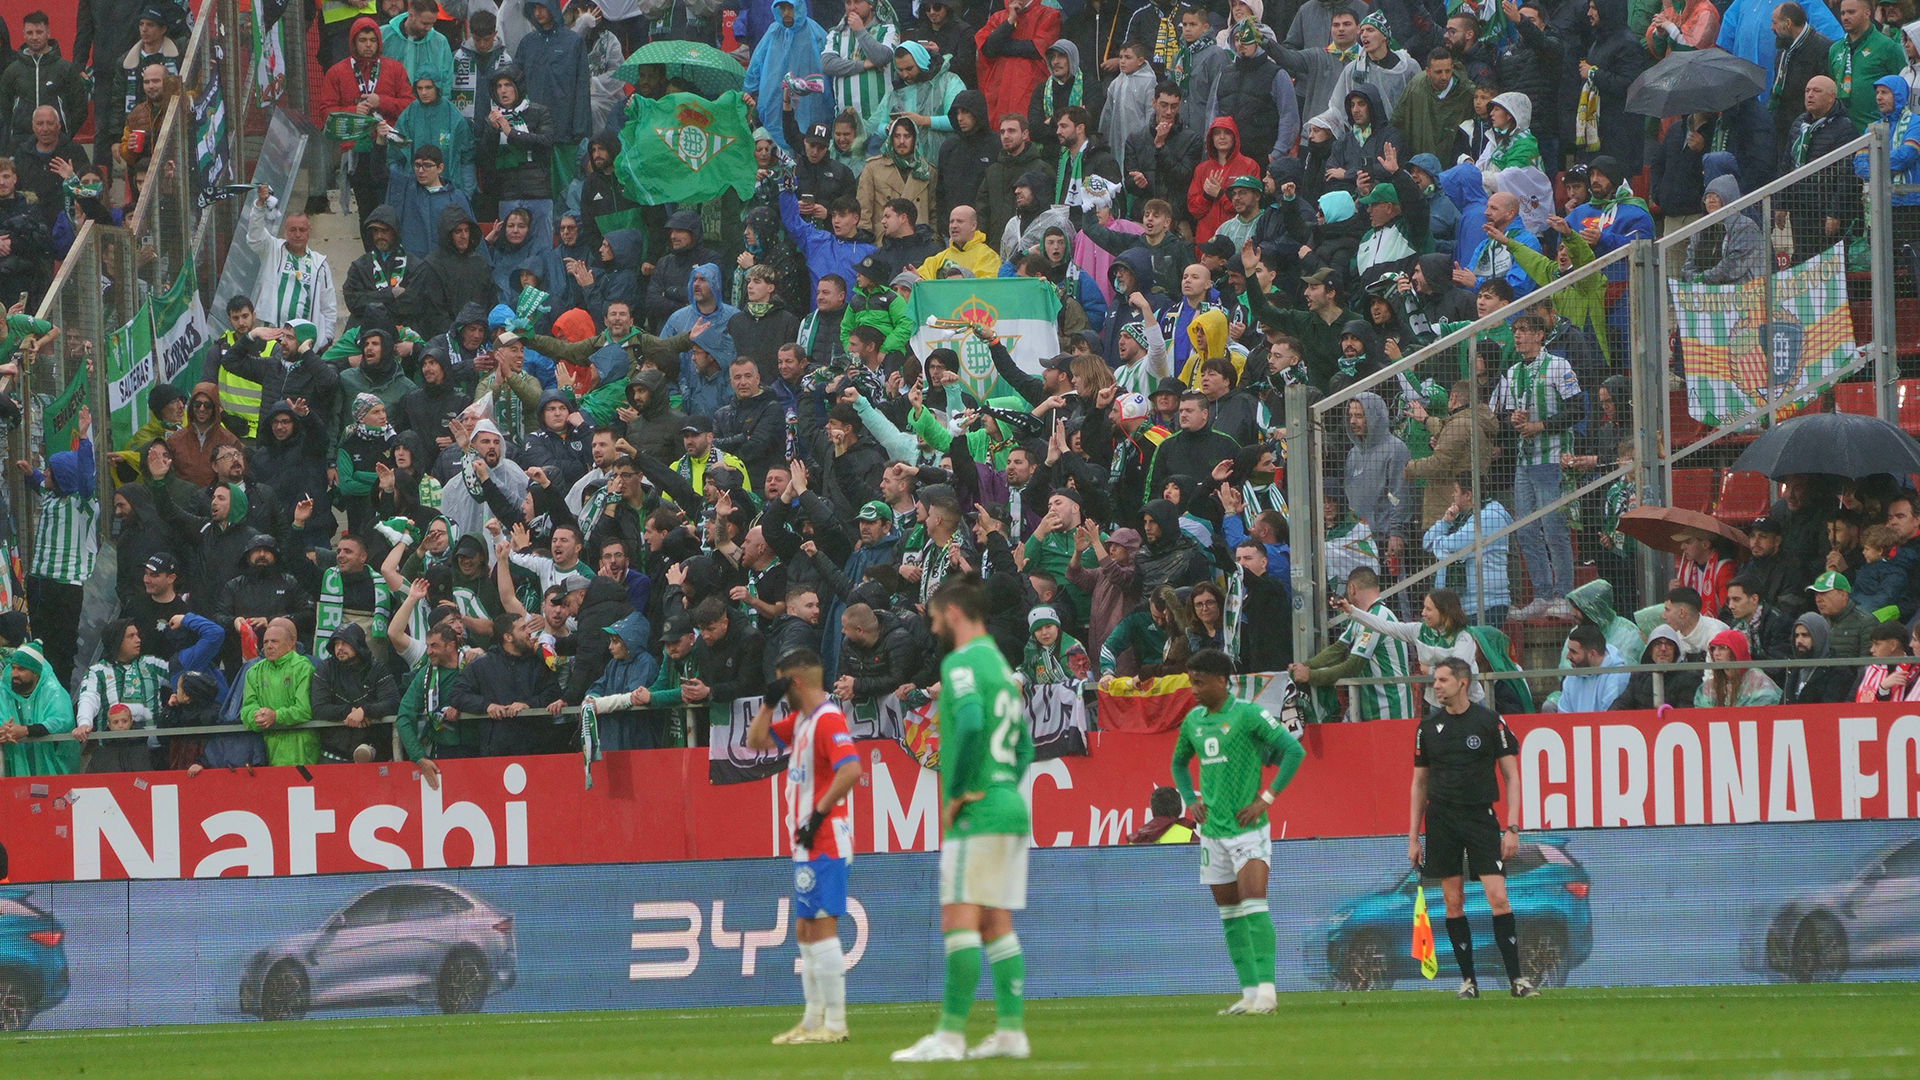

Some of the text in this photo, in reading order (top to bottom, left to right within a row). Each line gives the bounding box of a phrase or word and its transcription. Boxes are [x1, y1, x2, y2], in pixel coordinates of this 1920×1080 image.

[118, 357, 150, 404] SALTERAS
[1134, 394, 1144, 405] 9
[1522, 719, 1815, 830] GIRONA
[72, 762, 529, 881] Natsbi
[629, 896, 869, 980] BYD
